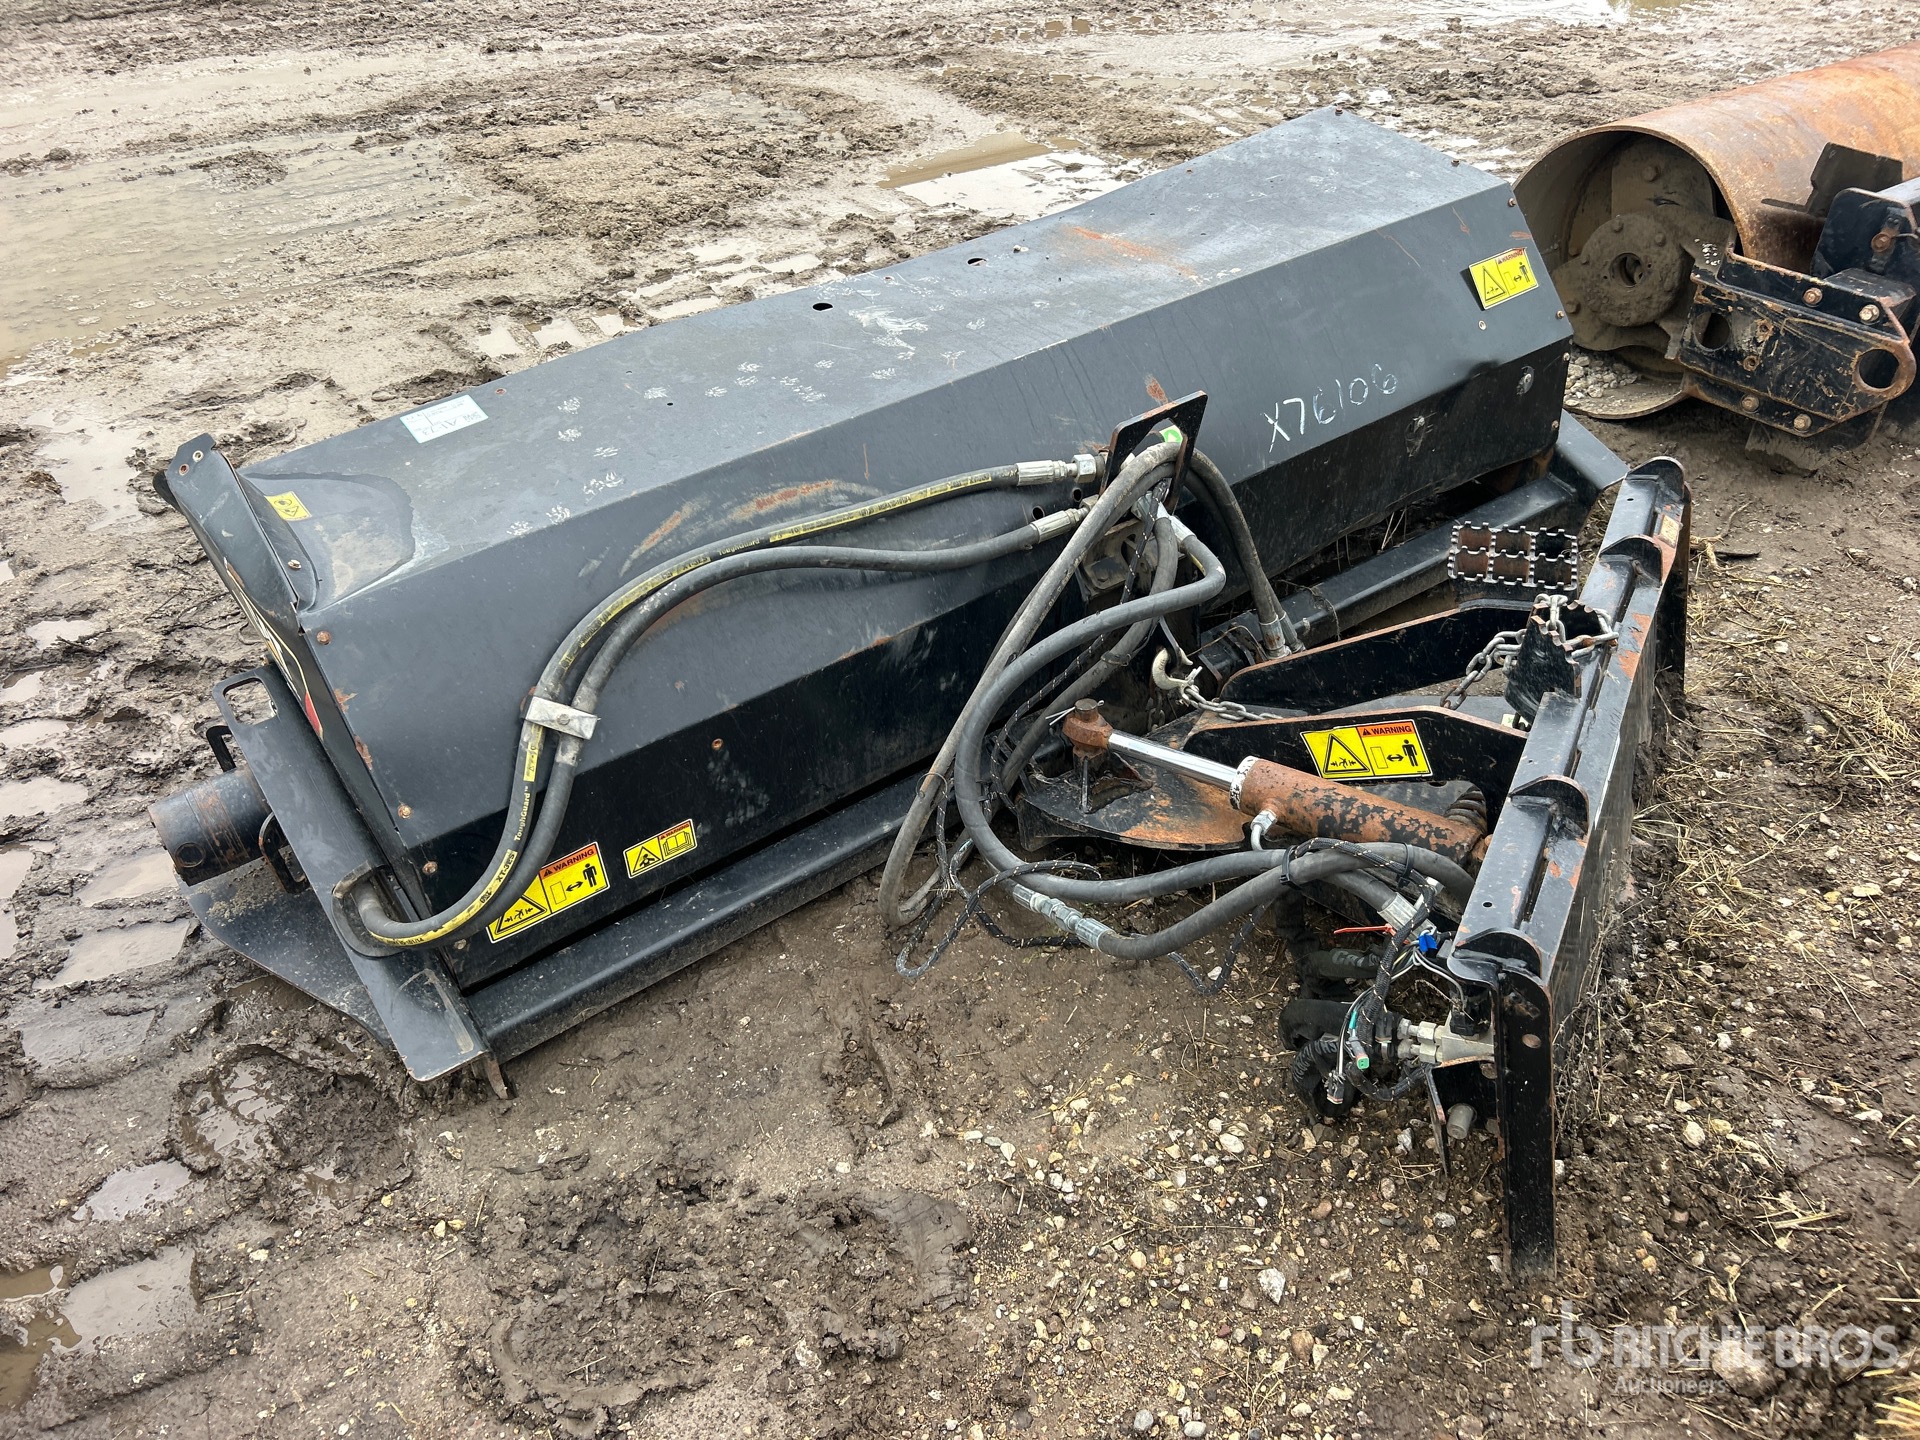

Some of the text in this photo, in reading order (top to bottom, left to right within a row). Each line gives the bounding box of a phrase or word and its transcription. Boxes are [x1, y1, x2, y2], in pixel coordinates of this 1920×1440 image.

[1502, 250, 1523, 262] WARNING
[1371, 726, 1412, 735] WARNING
[665, 823, 690, 837] WARNING
[553, 848, 595, 872] WARNING
